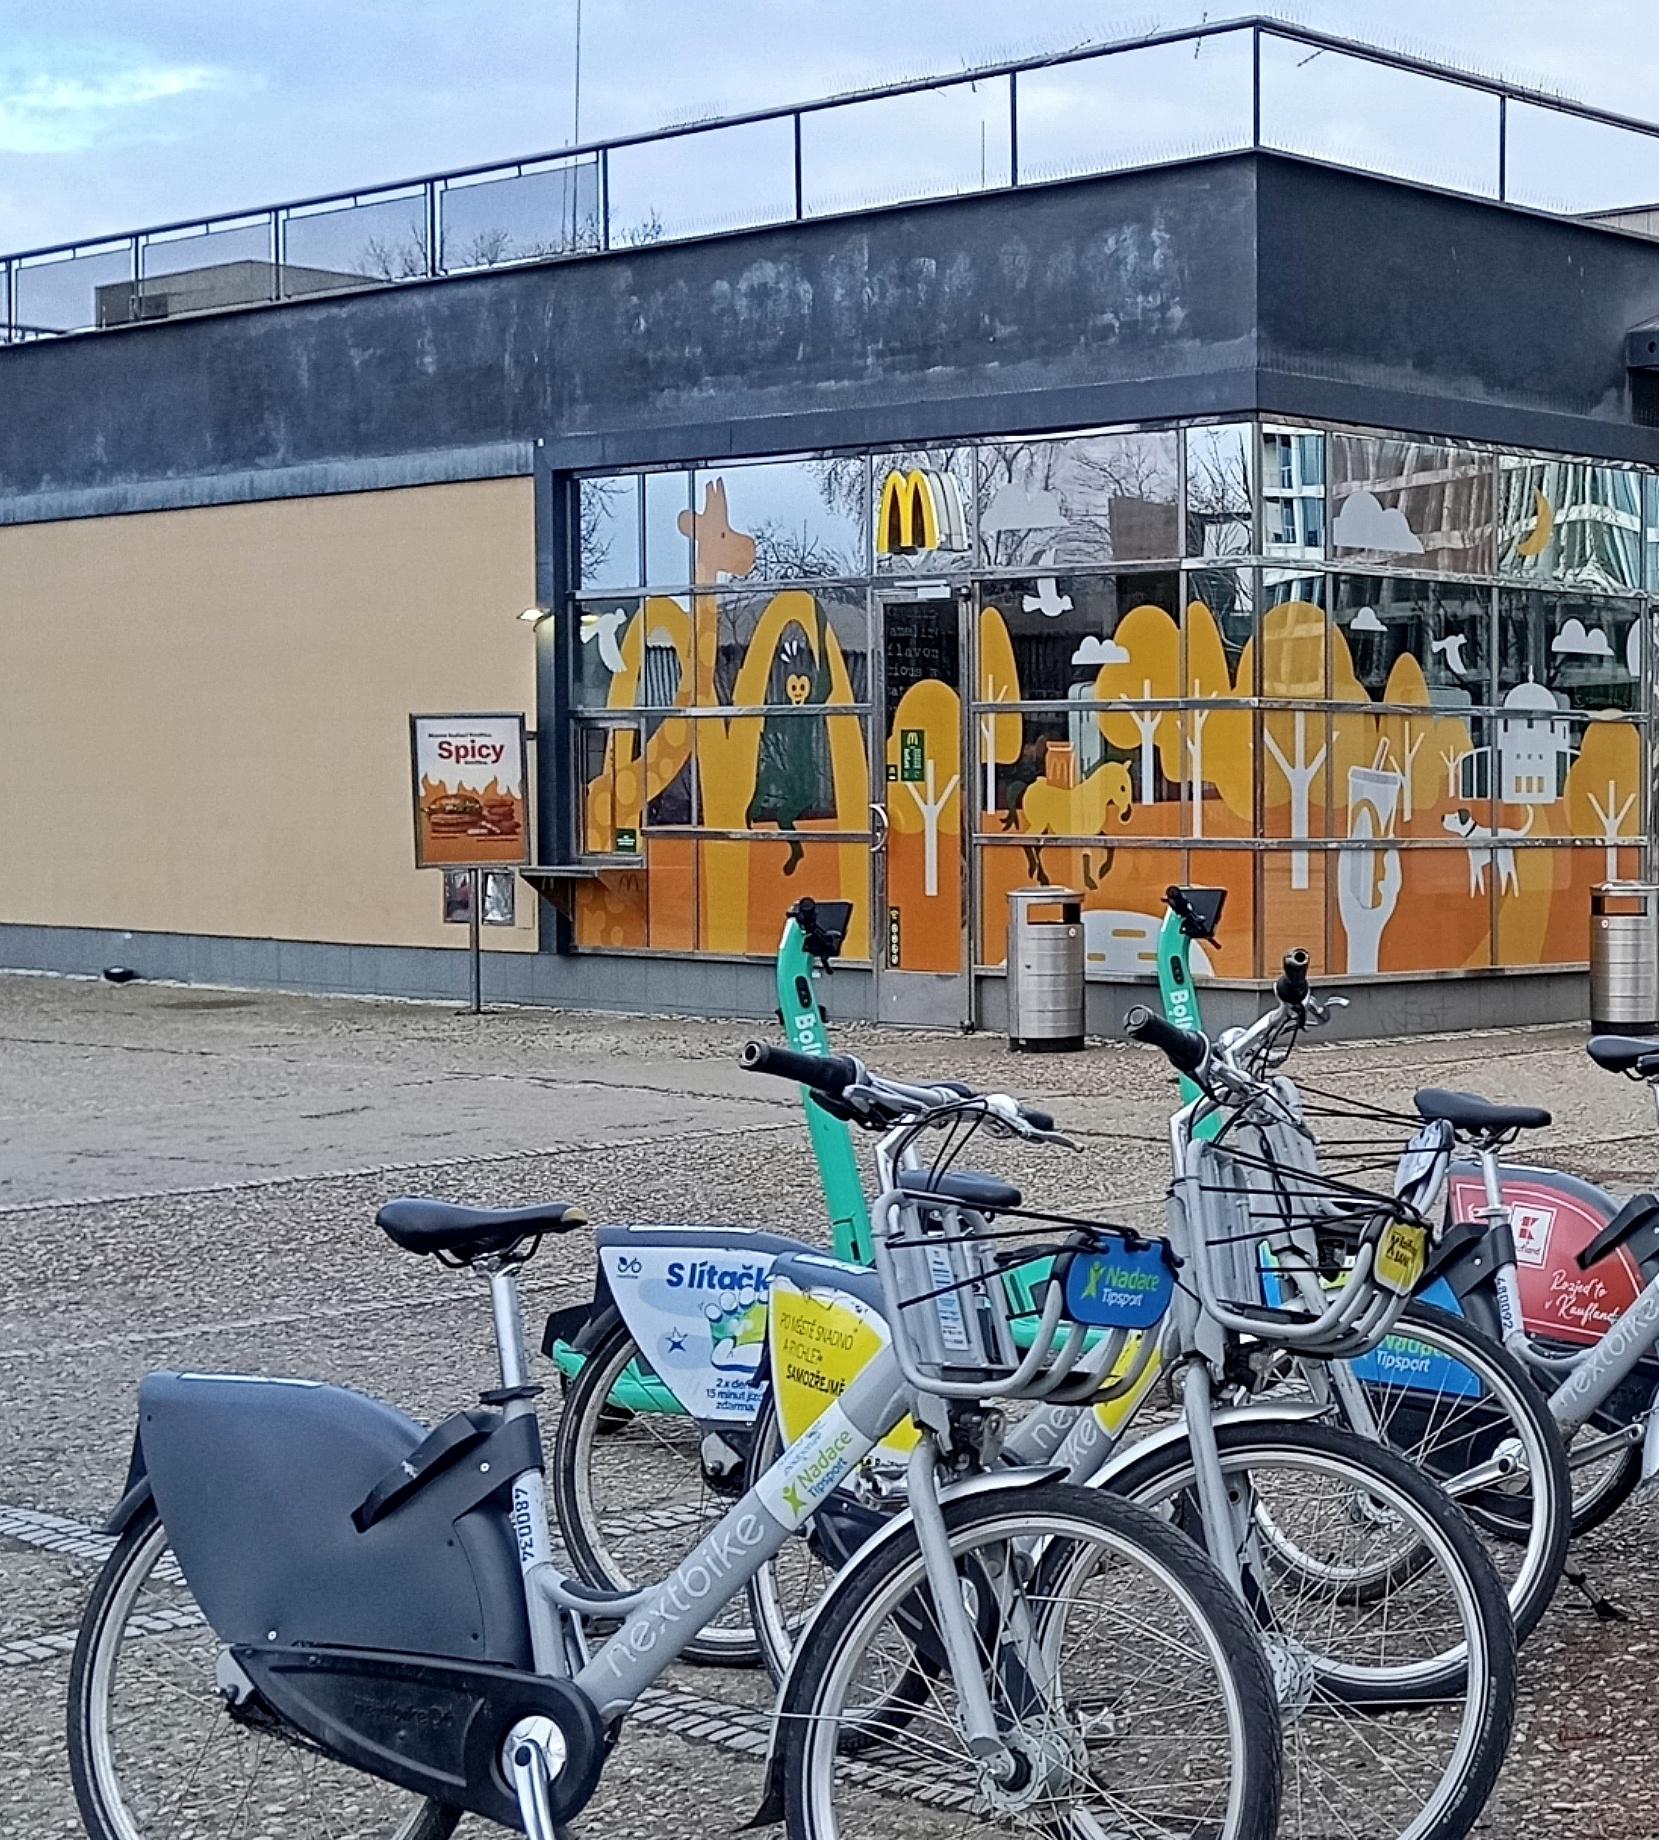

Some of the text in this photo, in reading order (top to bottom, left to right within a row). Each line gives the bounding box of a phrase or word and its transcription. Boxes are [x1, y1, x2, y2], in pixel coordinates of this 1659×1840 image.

[438, 739, 505, 765] Spicy
[688, 1259, 770, 1292] lítačk
[1106, 1266, 1161, 1292] Nadace
[1102, 1287, 1144, 1308] Tipsport
[1556, 1294, 1620, 1327] Kaufland
[1377, 1350, 1431, 1374] Tipsport
[706, 1388, 716, 1399] 15
[717, 1389, 746, 1400] minut
[715, 1377, 723, 1388] 2
[797, 1430, 853, 1489] Nadace
[807, 1457, 849, 1498] Tipsport
[514, 1488, 534, 1562] 480034
[606, 1512, 765, 1679] nextbike
